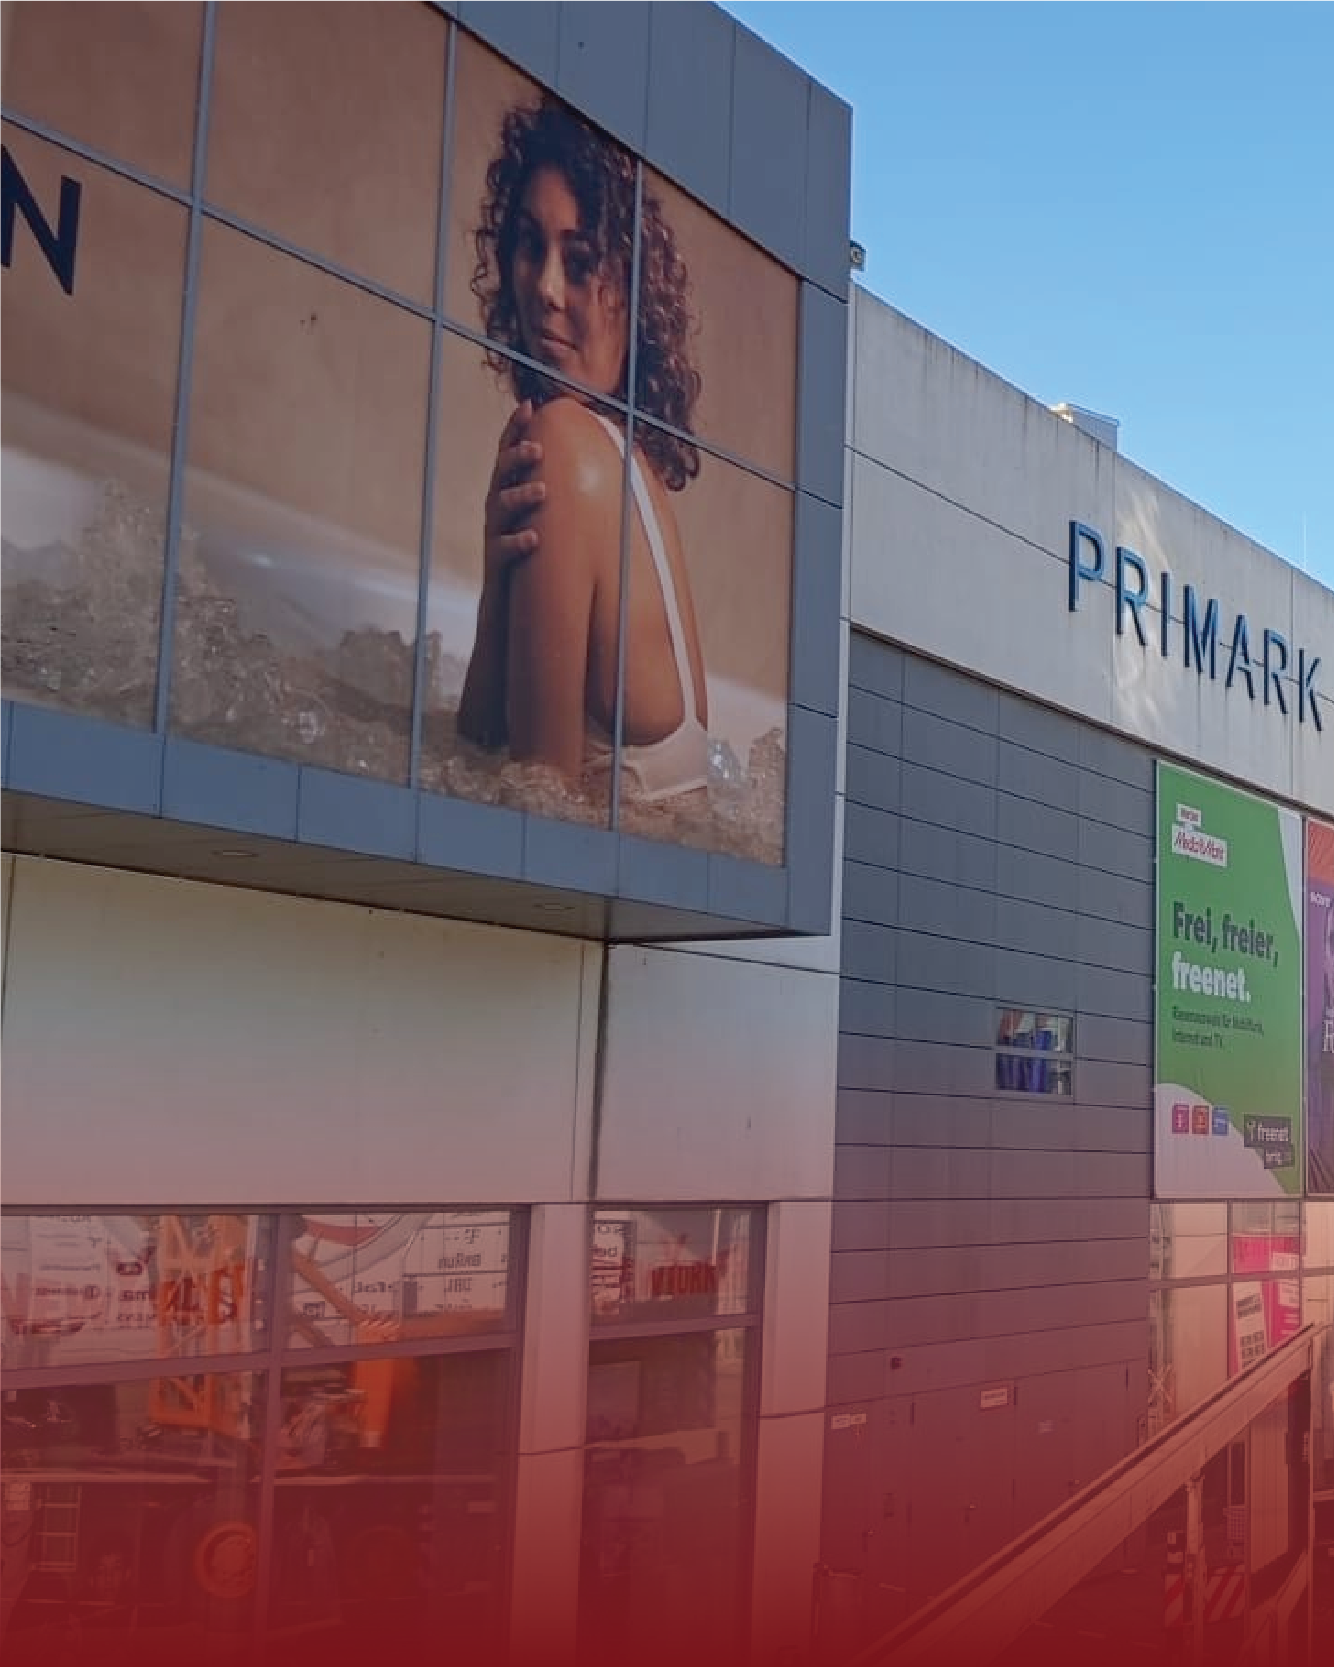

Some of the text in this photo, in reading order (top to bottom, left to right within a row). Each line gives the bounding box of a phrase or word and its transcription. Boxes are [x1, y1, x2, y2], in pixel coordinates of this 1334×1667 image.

[1068, 519, 1323, 732] PRIMARK
[1173, 900, 1279, 968] Frei, freier,
[1172, 951, 1252, 1003] freenet.
